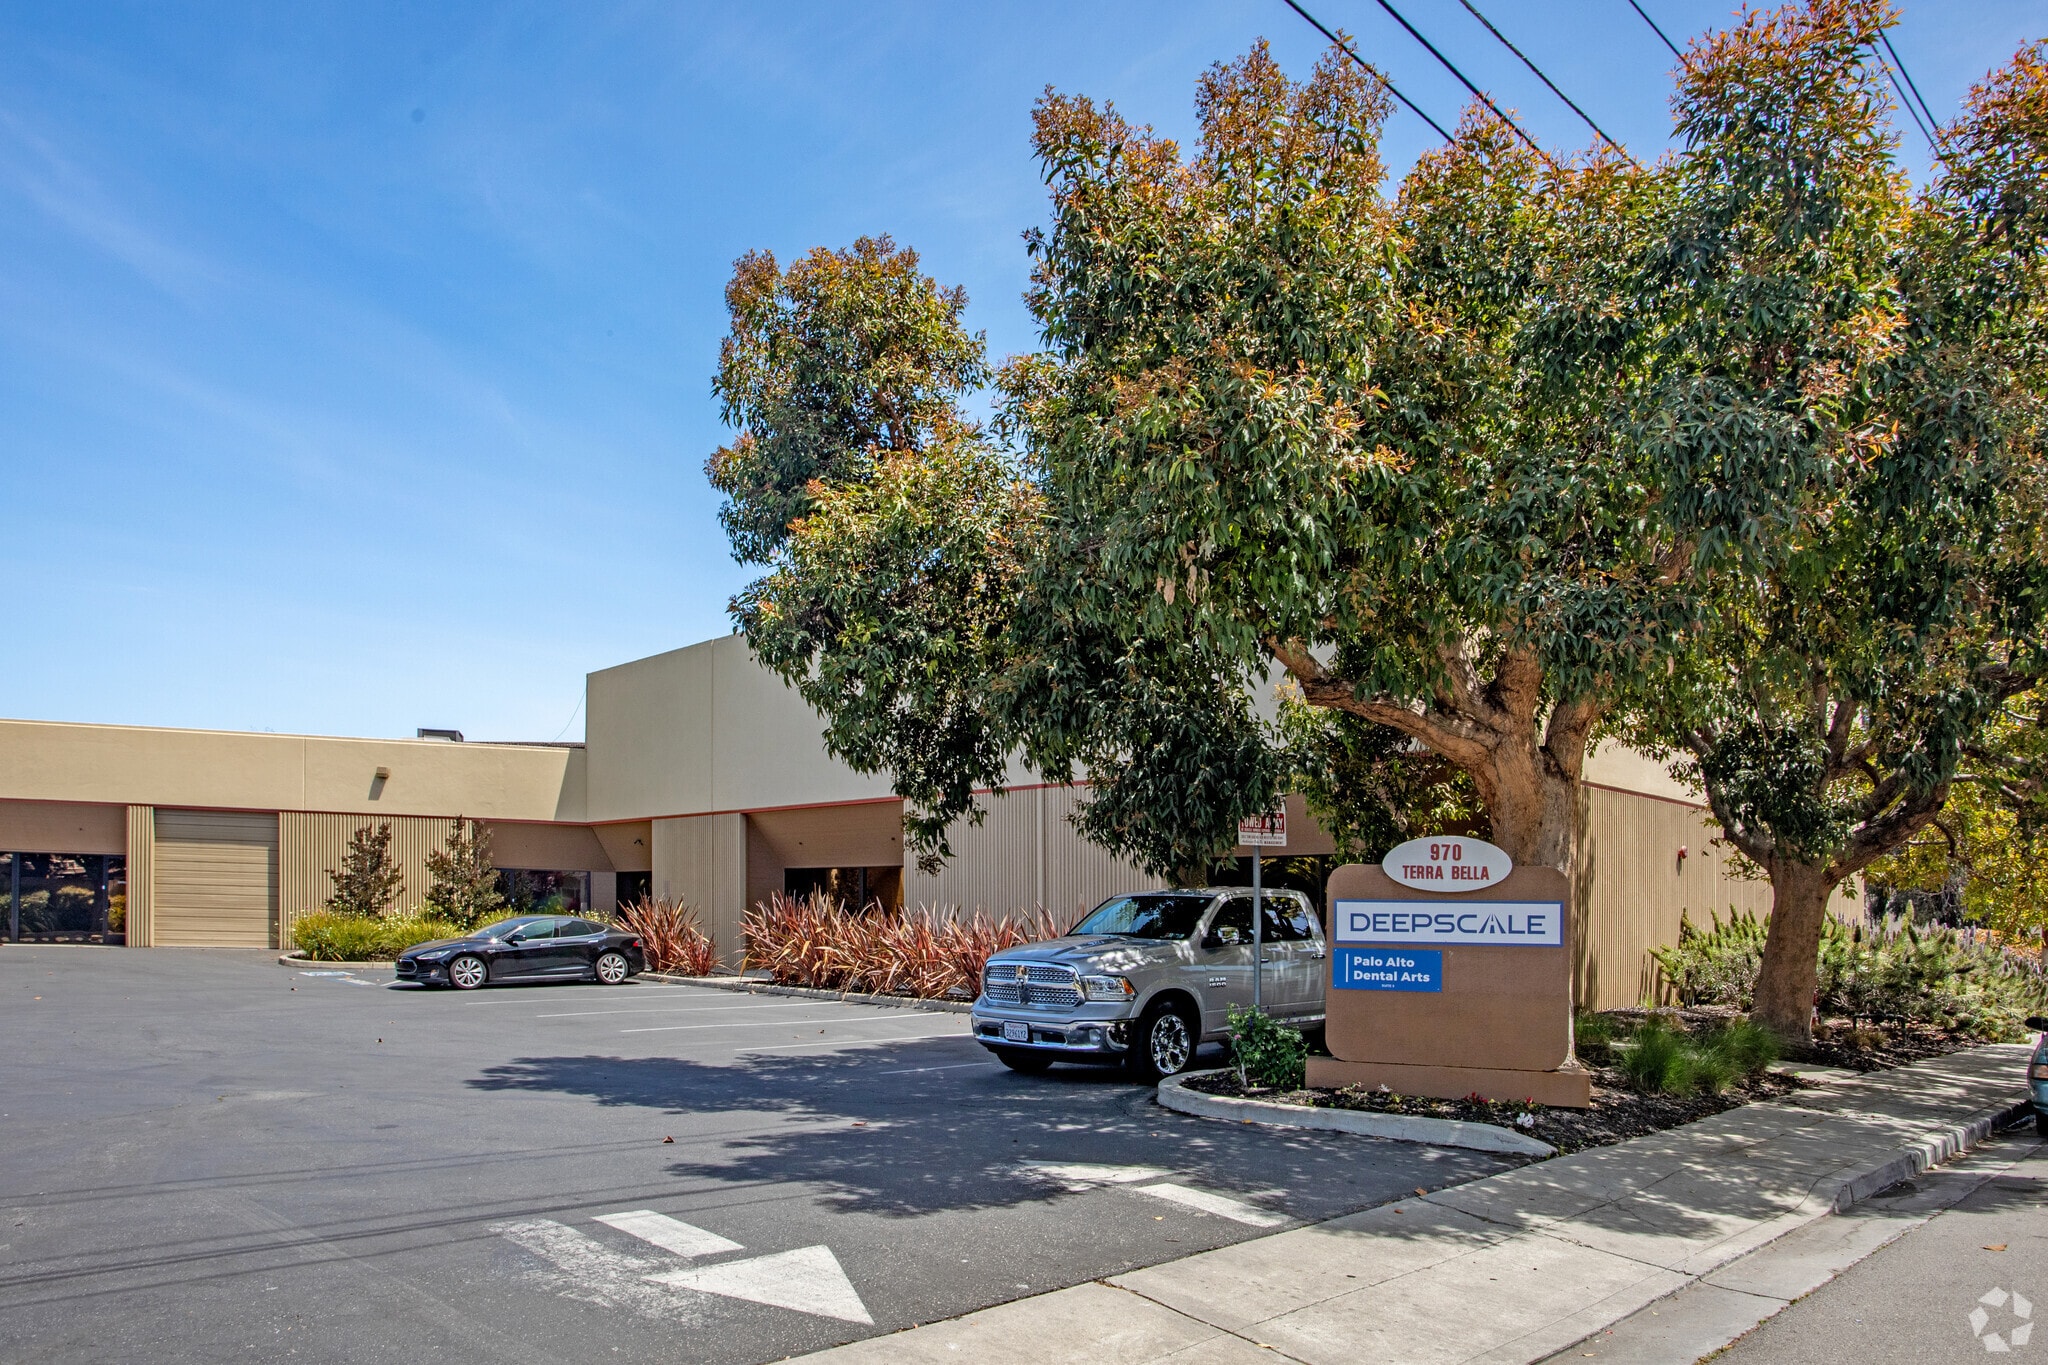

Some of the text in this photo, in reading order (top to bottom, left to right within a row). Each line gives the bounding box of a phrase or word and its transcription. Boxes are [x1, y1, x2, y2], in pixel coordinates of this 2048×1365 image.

[1430, 843, 1462, 861] 970
[1402, 865, 1490, 880] TERRA BELLA
[1350, 913, 1546, 935] DEEPSCALE
[1353, 956, 1415, 968] Palo Alto
[1353, 970, 1430, 983] Dental Arts
